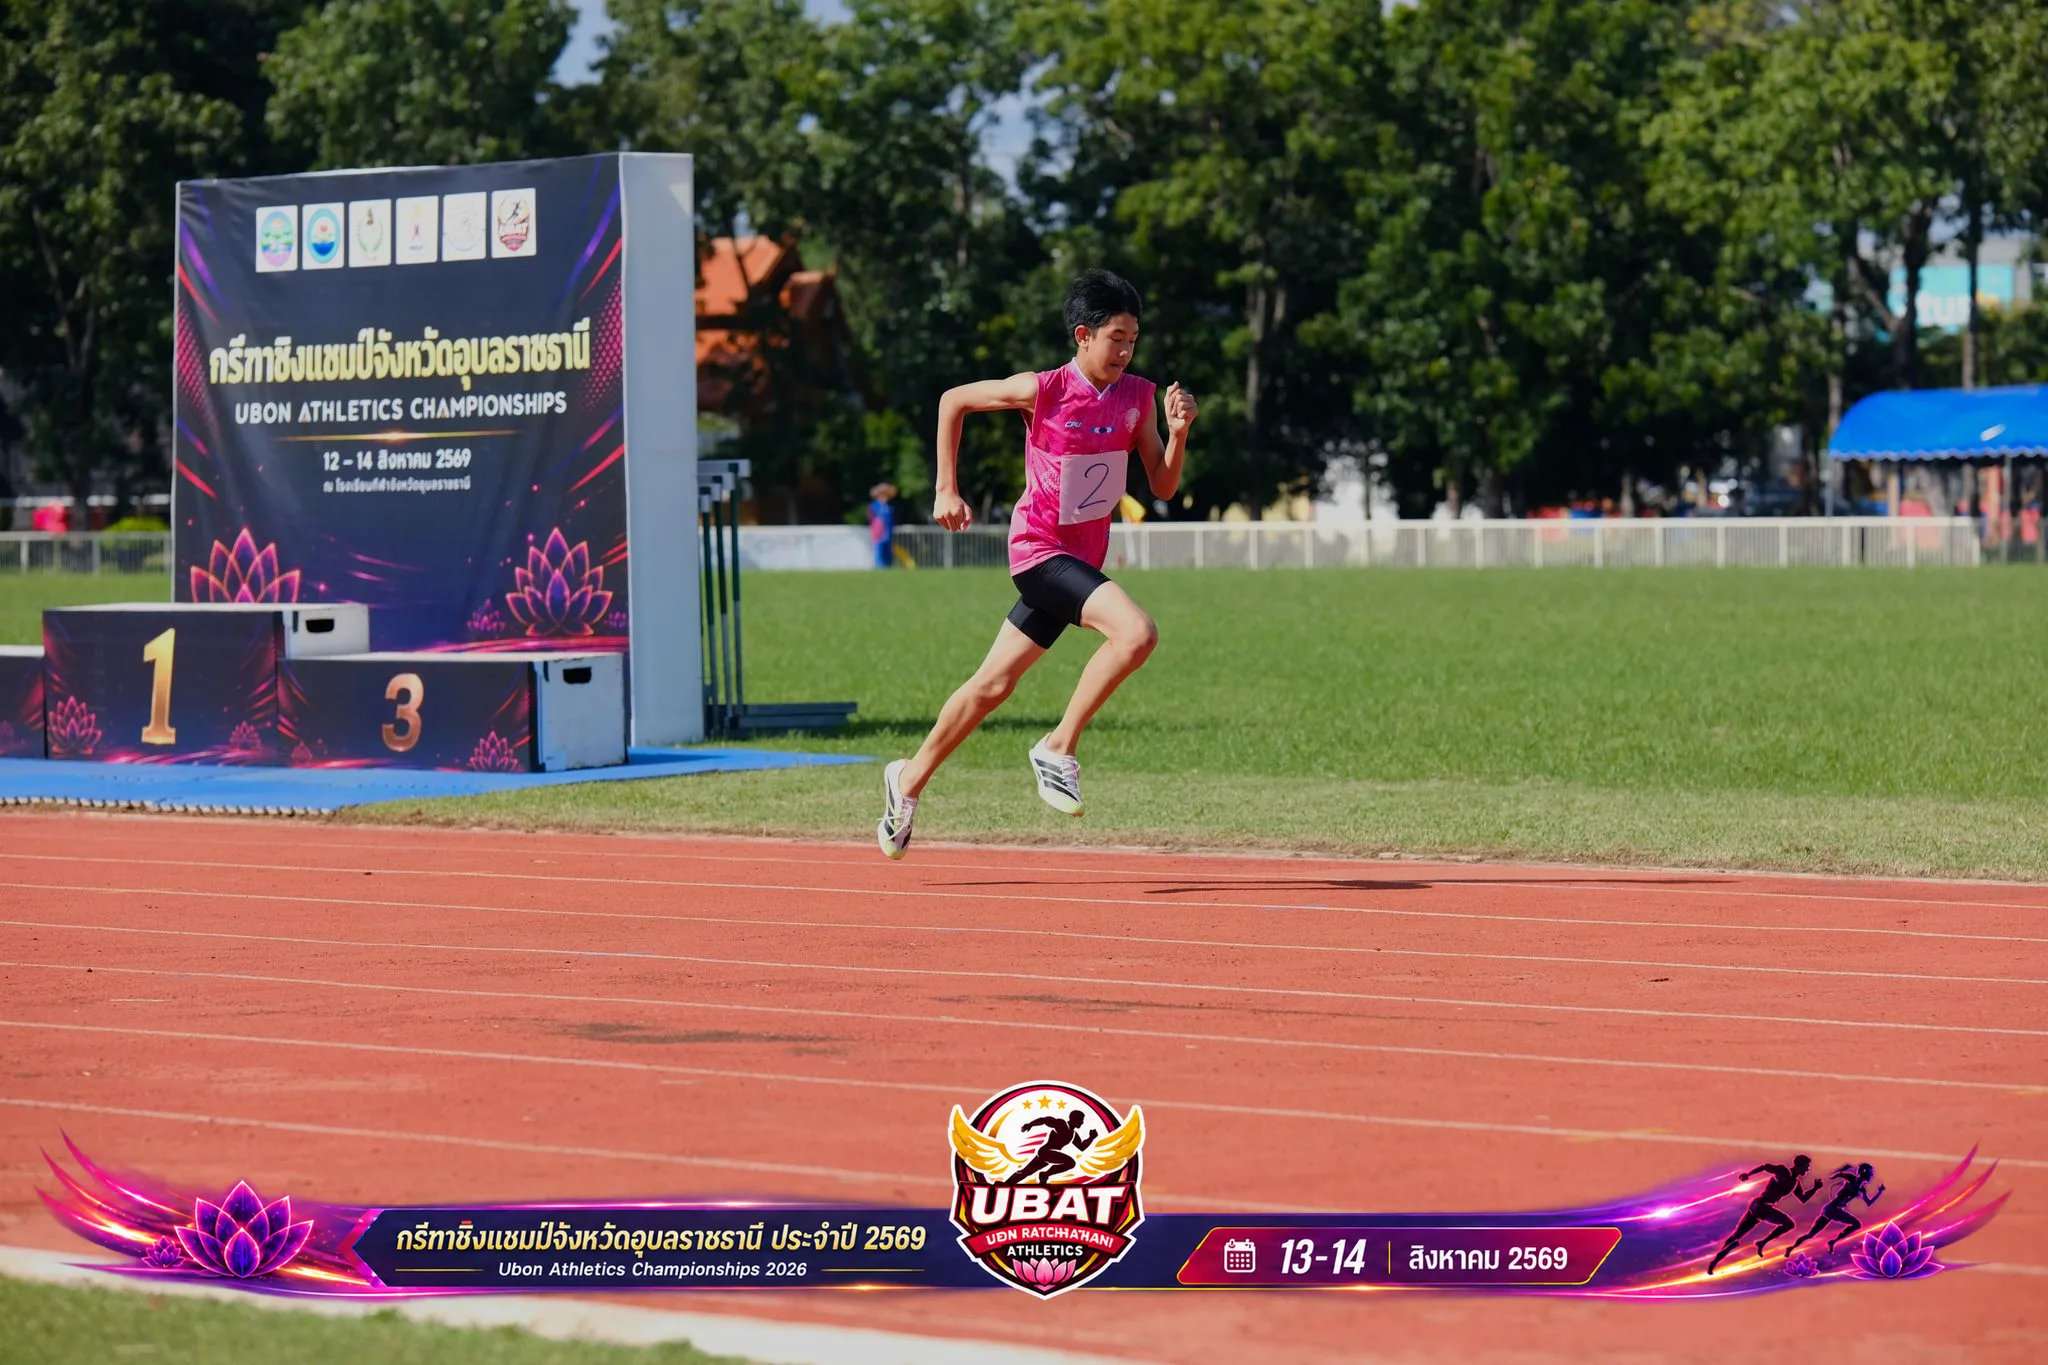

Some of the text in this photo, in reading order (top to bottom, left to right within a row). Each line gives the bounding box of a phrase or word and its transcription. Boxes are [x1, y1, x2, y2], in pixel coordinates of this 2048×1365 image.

[235, 391, 567, 424] UBON ATHLETICS CHAMPIONSHIPS
[323, 451, 340, 471] 12
[356, 451, 373, 470] 14
[377, 449, 432, 470] สิงหาคม
[435, 448, 472, 469] 2569
[1078, 463, 1109, 509] 2
[142, 627, 176, 744] 1
[381, 672, 425, 752] 3
